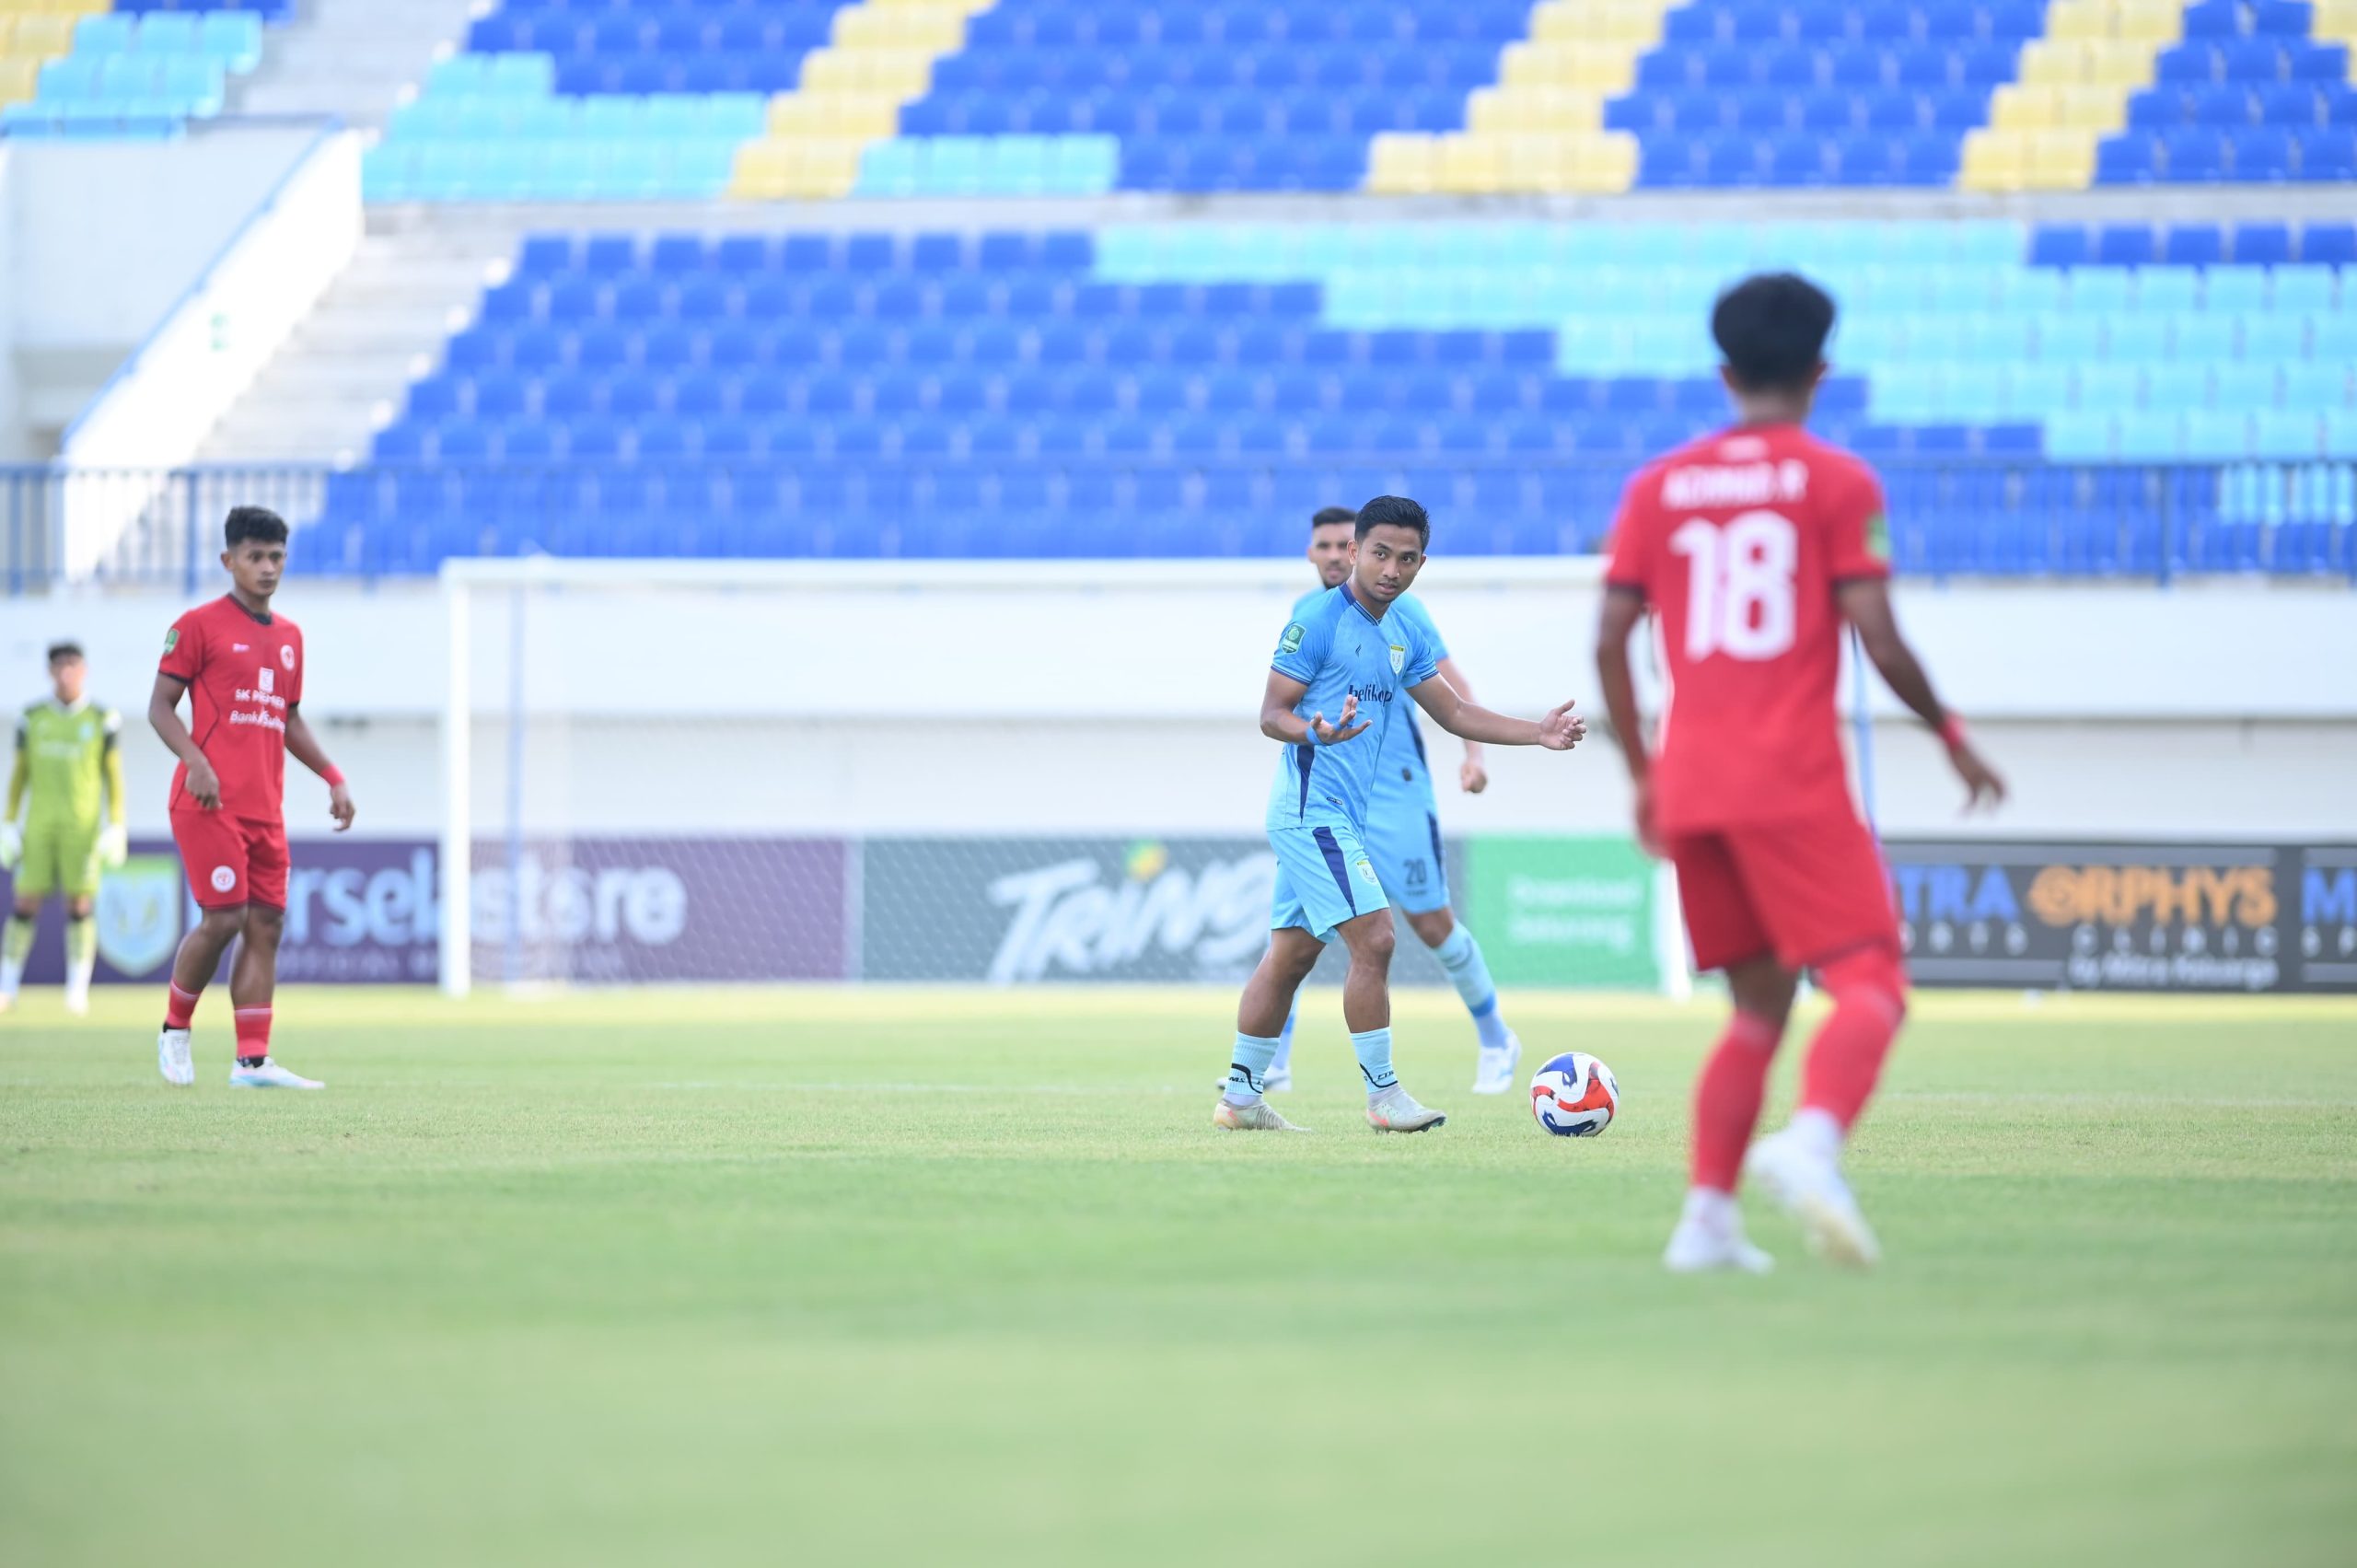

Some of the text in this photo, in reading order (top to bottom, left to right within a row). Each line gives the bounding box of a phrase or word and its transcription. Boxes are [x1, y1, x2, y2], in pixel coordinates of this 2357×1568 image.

[1667, 509, 1799, 665] 18
[1403, 858, 1427, 886] 20
[1897, 864, 2278, 928] TRA ORPHYS
